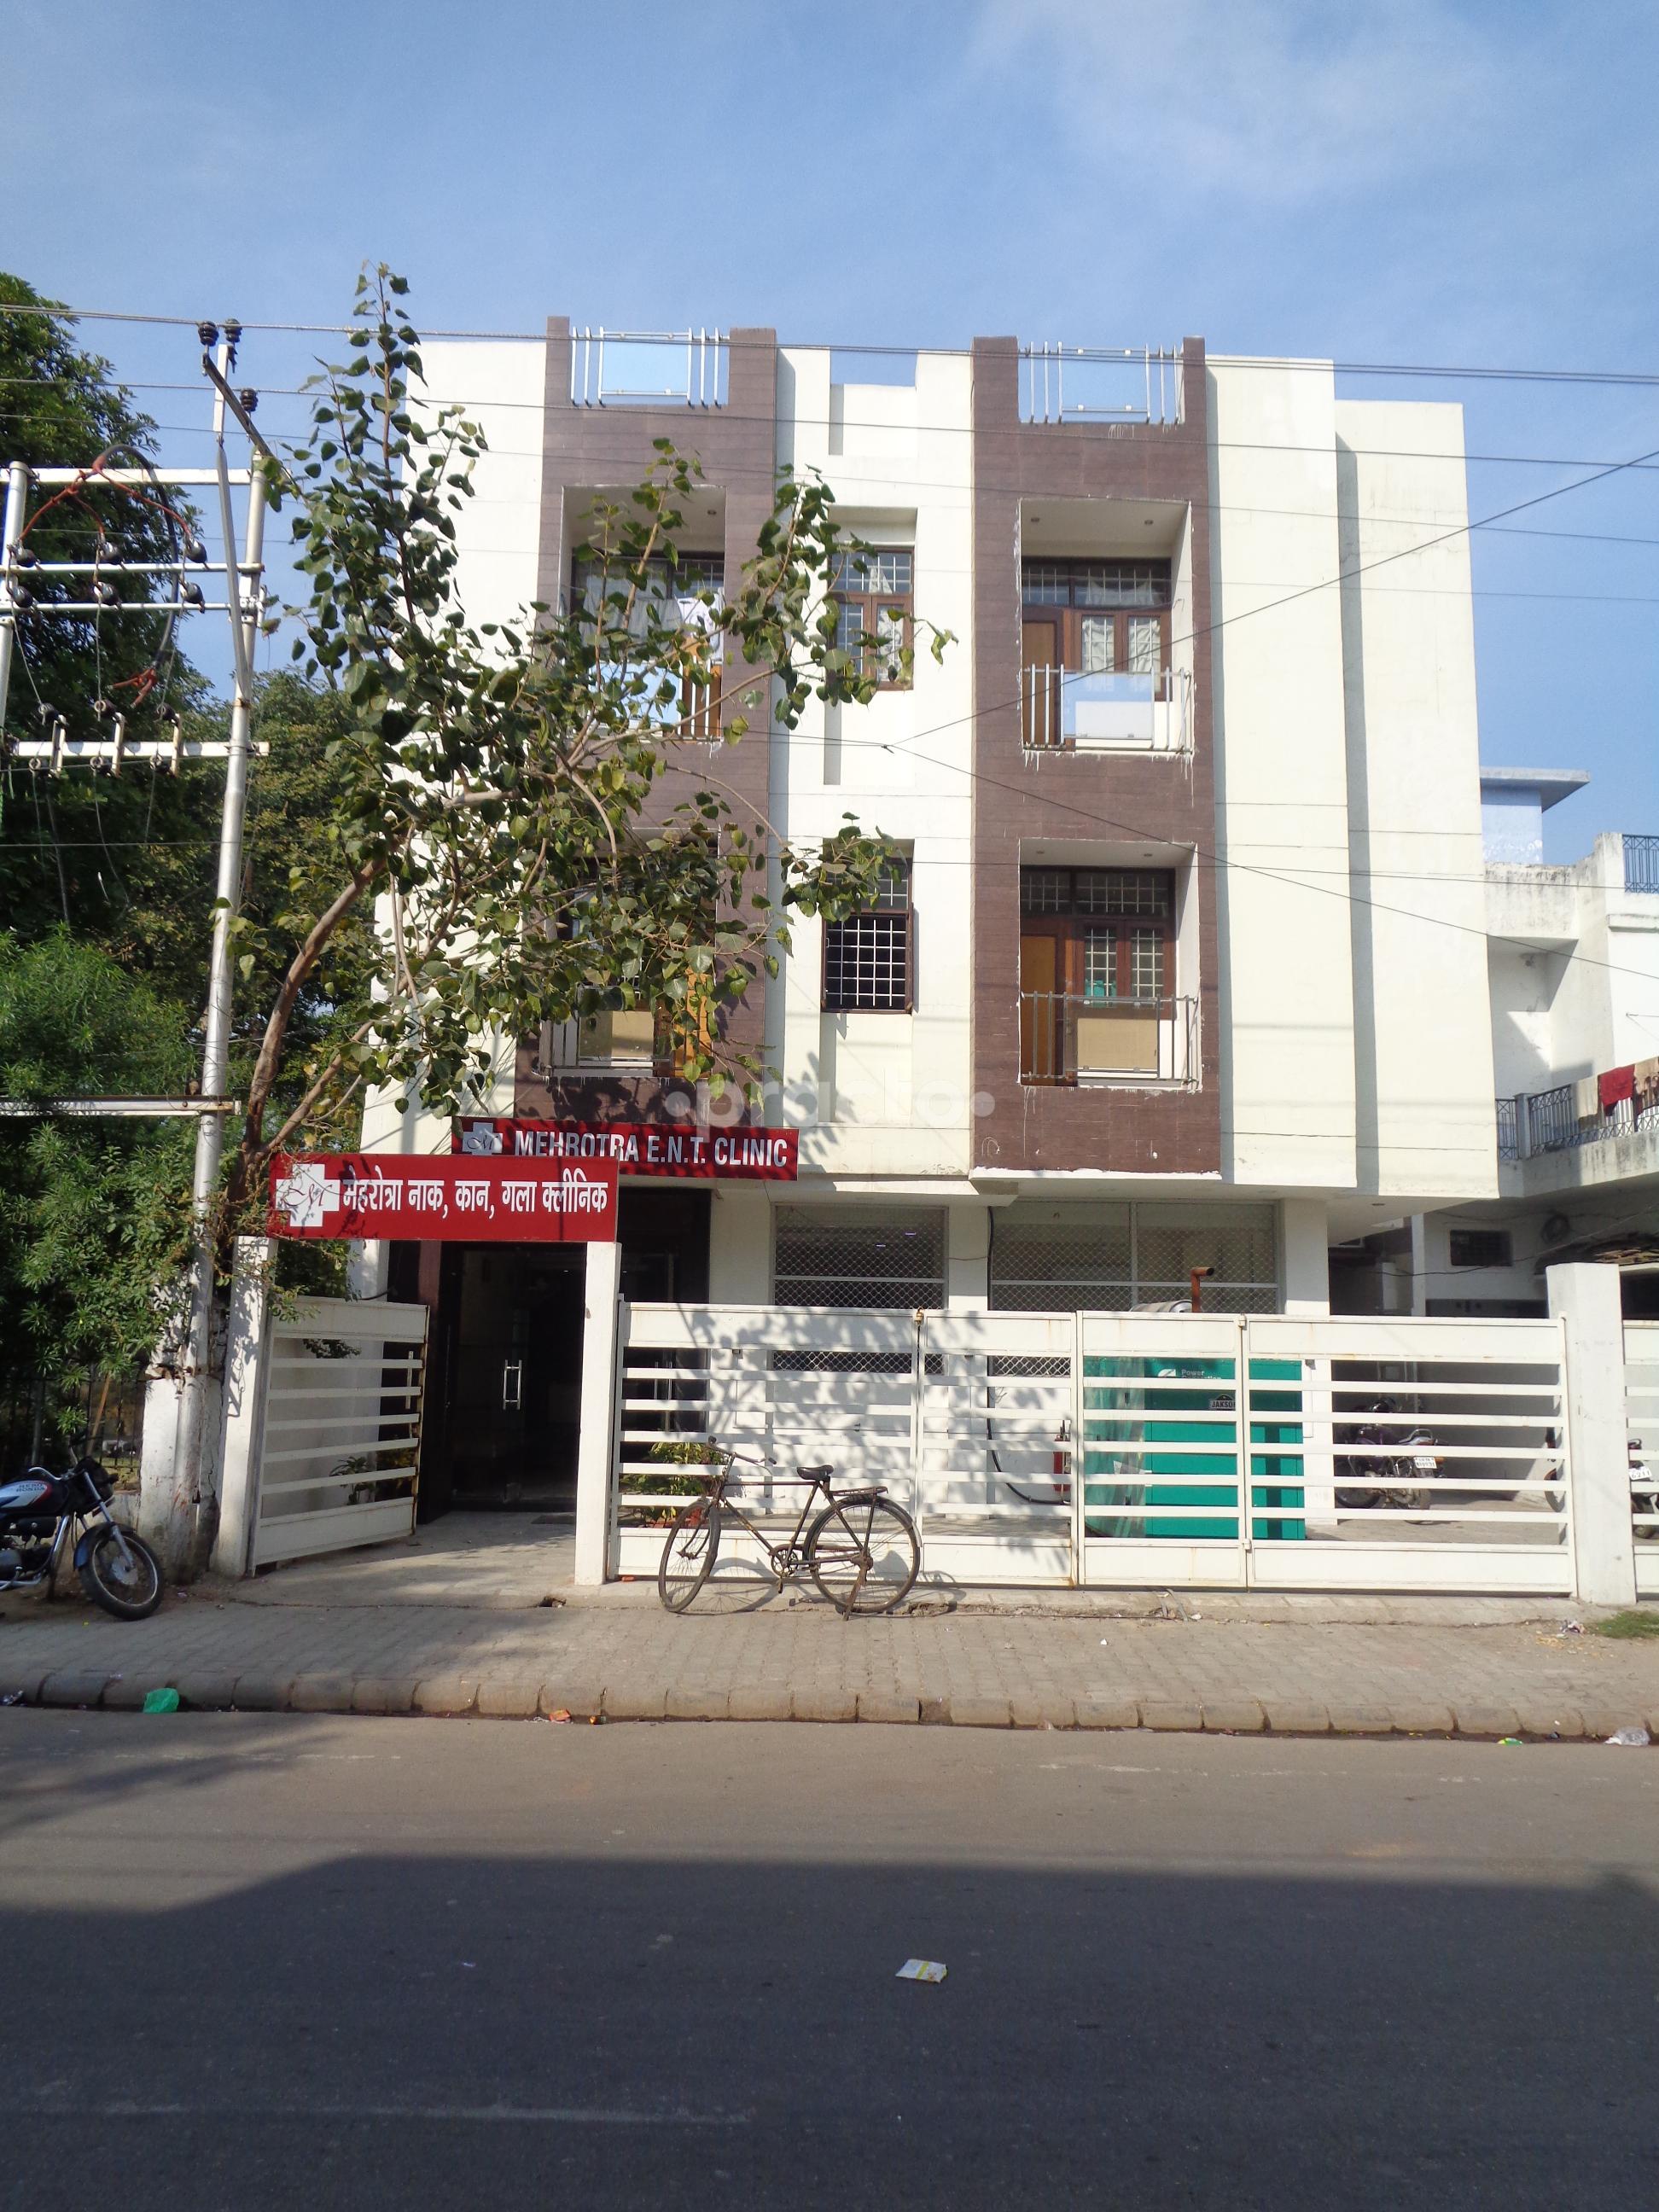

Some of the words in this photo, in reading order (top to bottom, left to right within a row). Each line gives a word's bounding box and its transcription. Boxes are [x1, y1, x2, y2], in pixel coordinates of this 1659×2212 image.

[515, 1130, 639, 1161] MEHROTRA
[647, 1135, 706, 1164] E.N.T.
[714, 1137, 788, 1167] CLINIC
[342, 1165, 404, 1214] मेहरोत्रा
[408, 1179, 449, 1219] नाक,
[455, 1180, 495, 1220] कान,
[501, 1181, 538, 1213] गला
[542, 1167, 608, 1214] क्लीनिक
